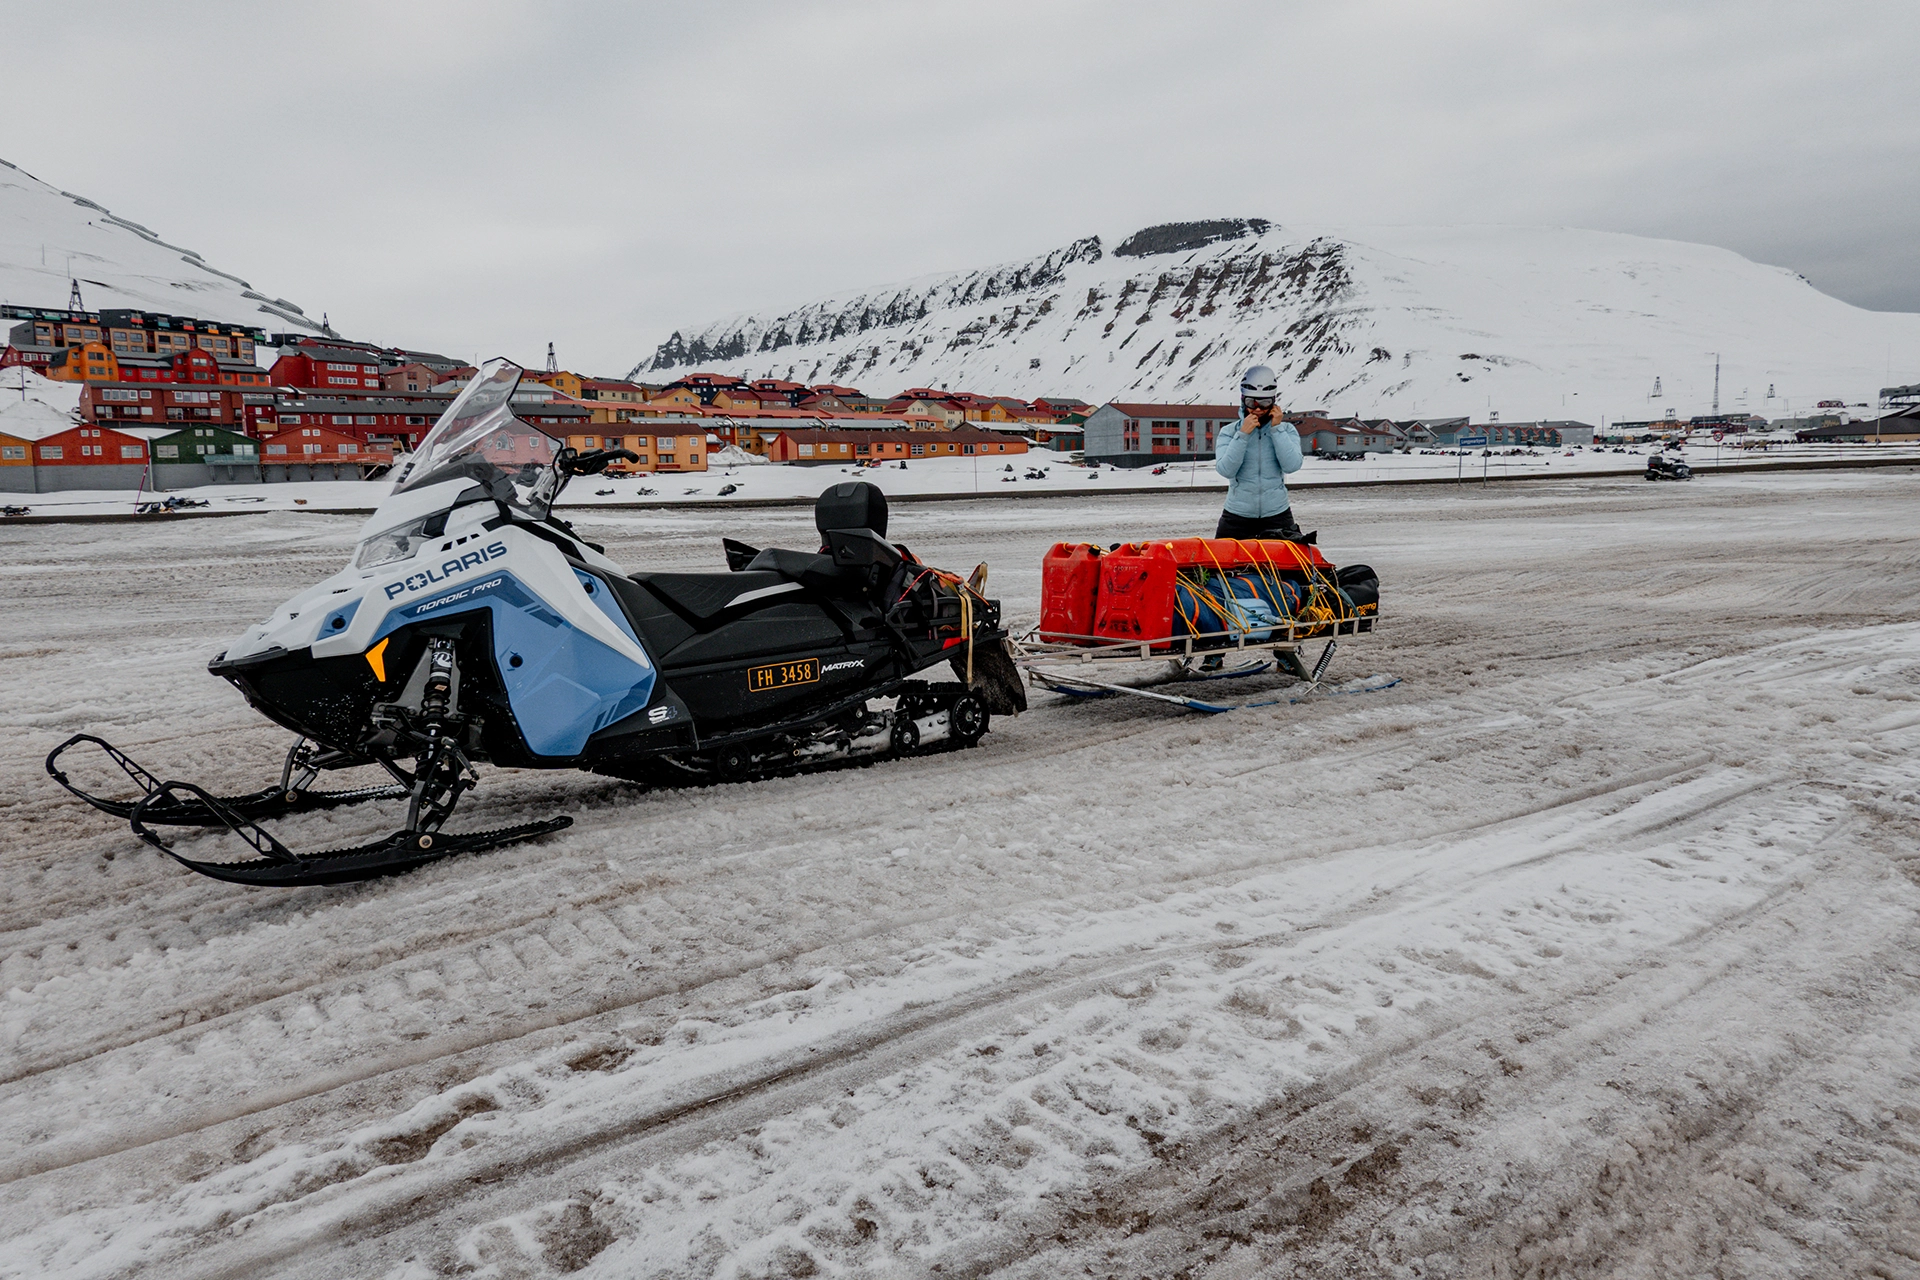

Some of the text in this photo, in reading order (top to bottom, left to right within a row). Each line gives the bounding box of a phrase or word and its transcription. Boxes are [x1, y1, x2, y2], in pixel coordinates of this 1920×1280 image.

[384, 541, 507, 600] POLARIS
[416, 578, 502, 613] NORDIC PRO
[757, 663, 811, 687] FH 3458
[821, 659, 865, 674] MATRYX
